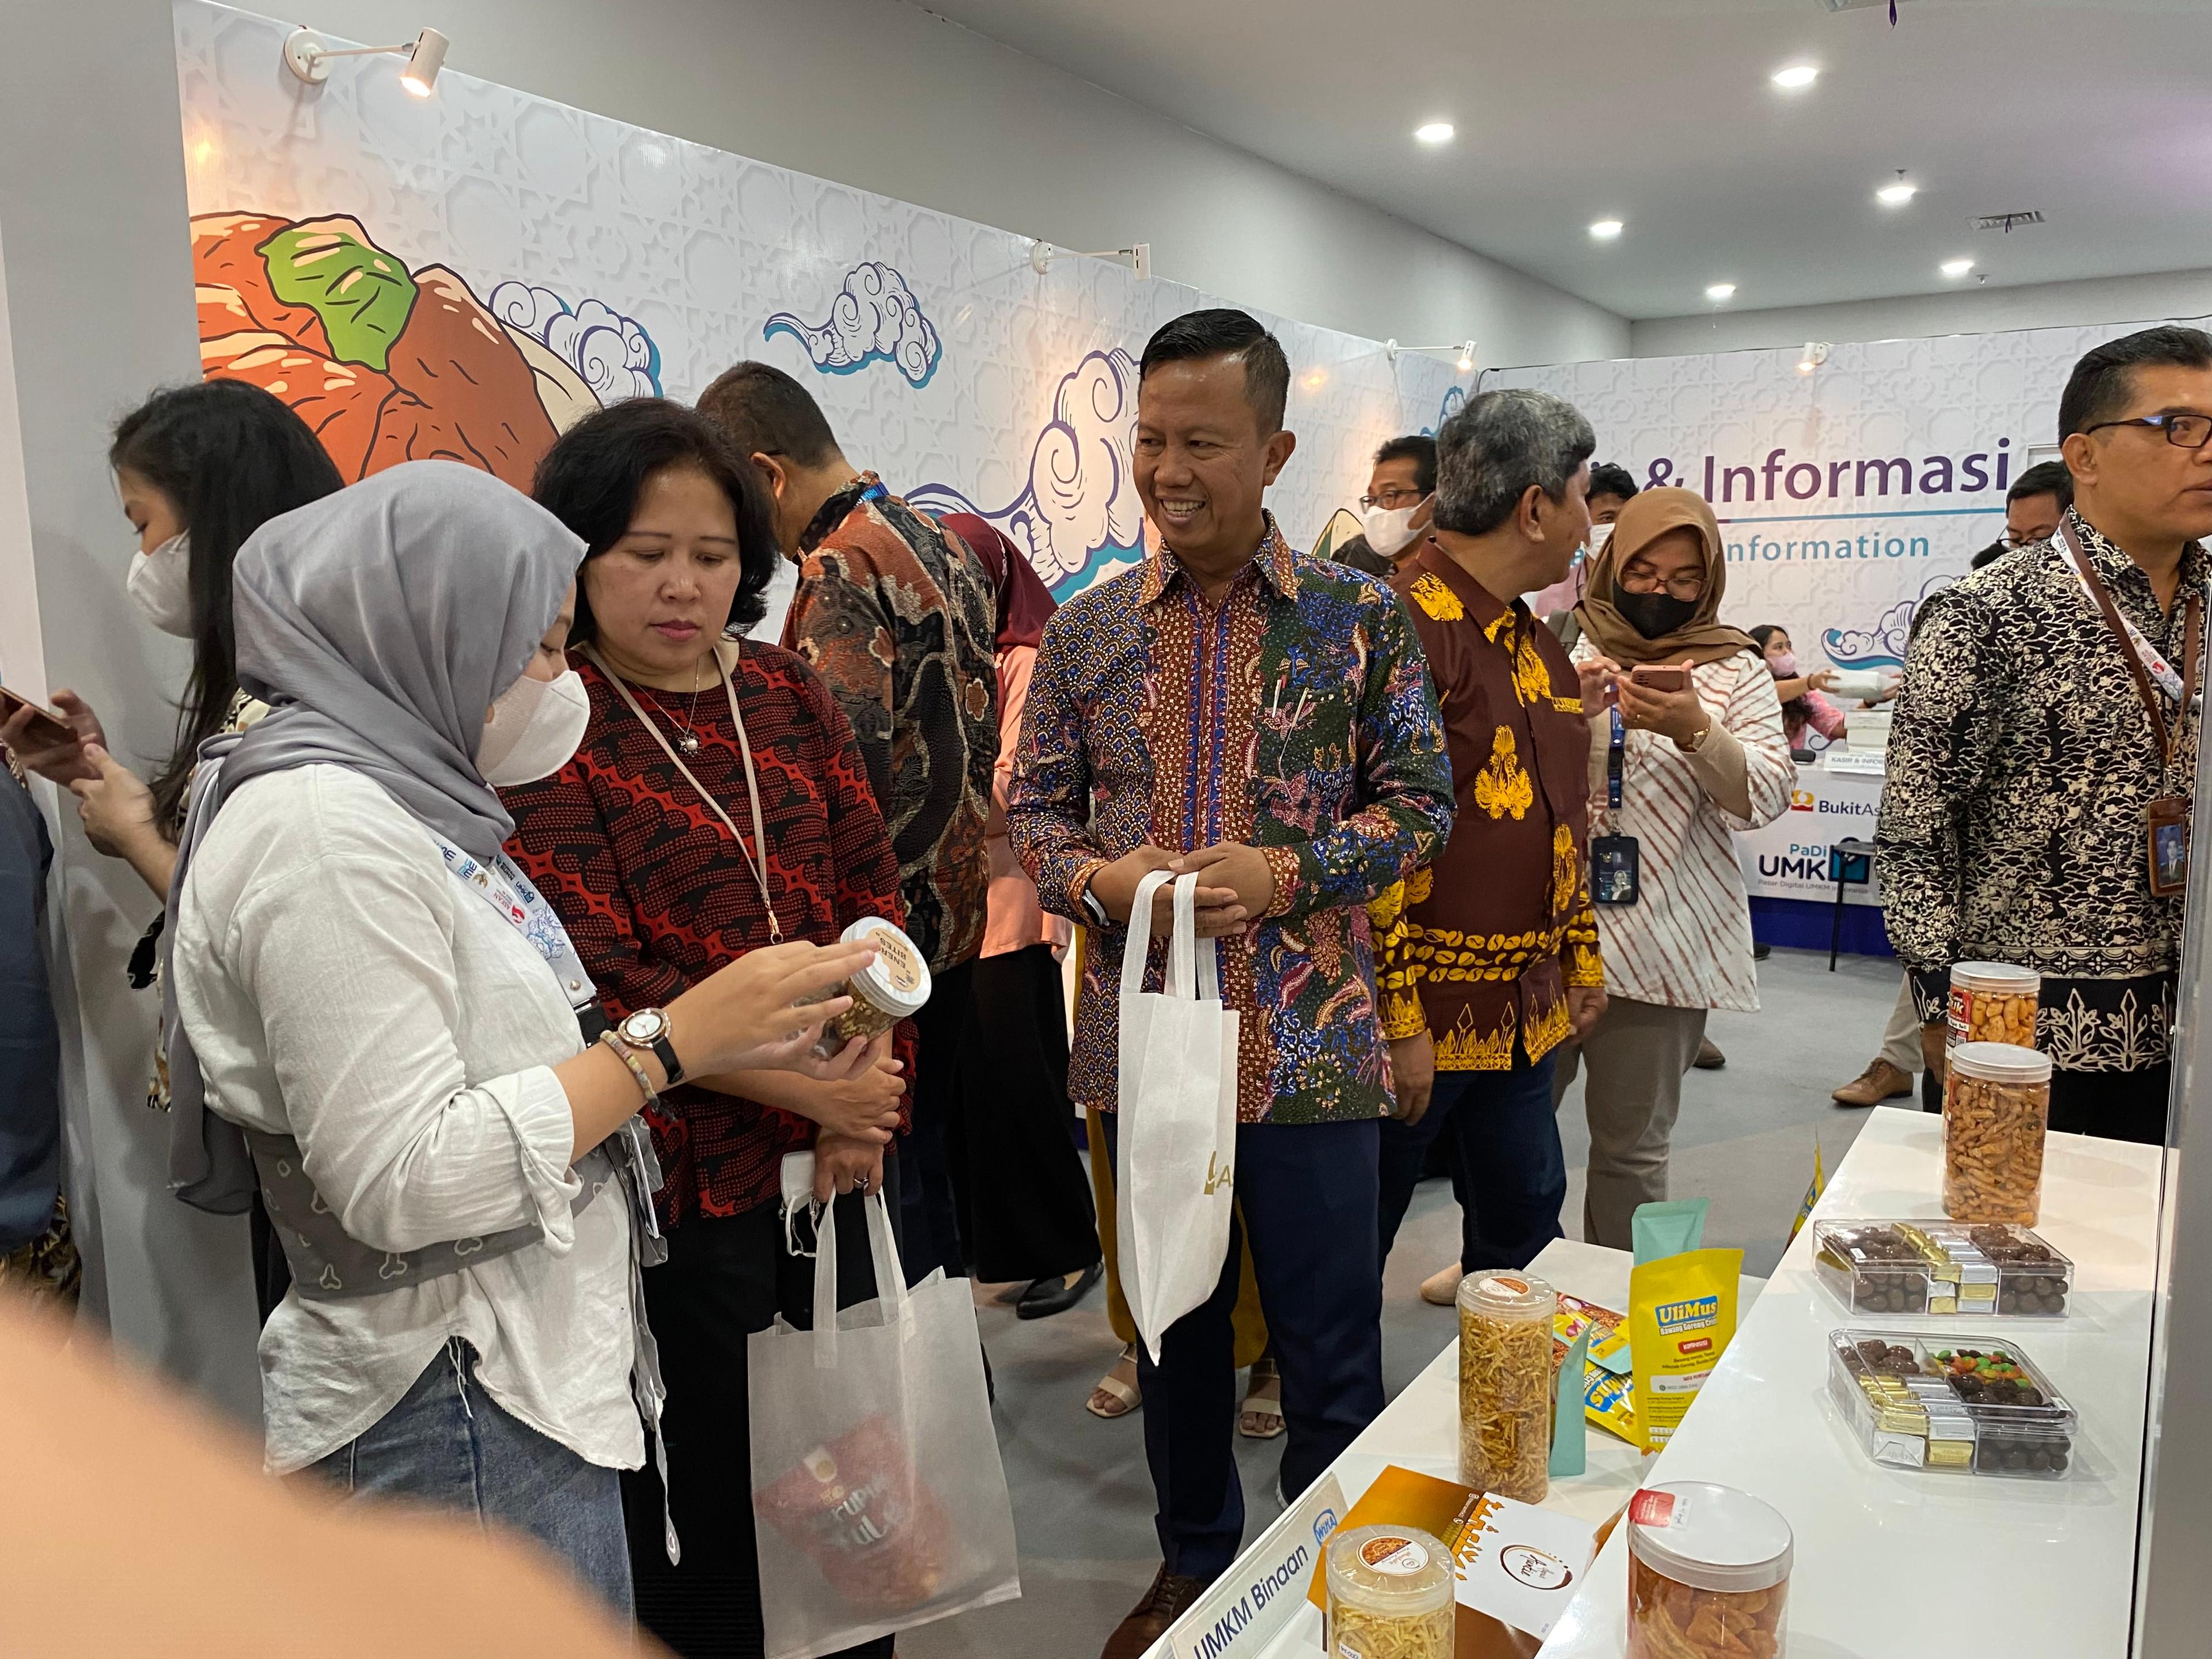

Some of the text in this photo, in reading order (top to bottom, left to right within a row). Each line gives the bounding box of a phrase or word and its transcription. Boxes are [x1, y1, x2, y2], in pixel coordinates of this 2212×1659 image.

[1643, 437, 2010, 503] & Informasi
[1725, 531, 1929, 562] nformation
[1819, 800, 1880, 817] BukitAs
[1790, 844, 1827, 857] PaDi
[1780, 880, 1804, 889] Digital
[1832, 885, 1868, 893] Inonesia
[493, 892, 510, 910] ASEAN
[880, 937, 907, 960] BITES
[881, 948, 906, 969] ENER
[1659, 1301, 1717, 1324] UliMus
[1660, 1325, 1684, 1336] Bawang
[1194, 1545, 1309, 1659] UMKM Binaan
